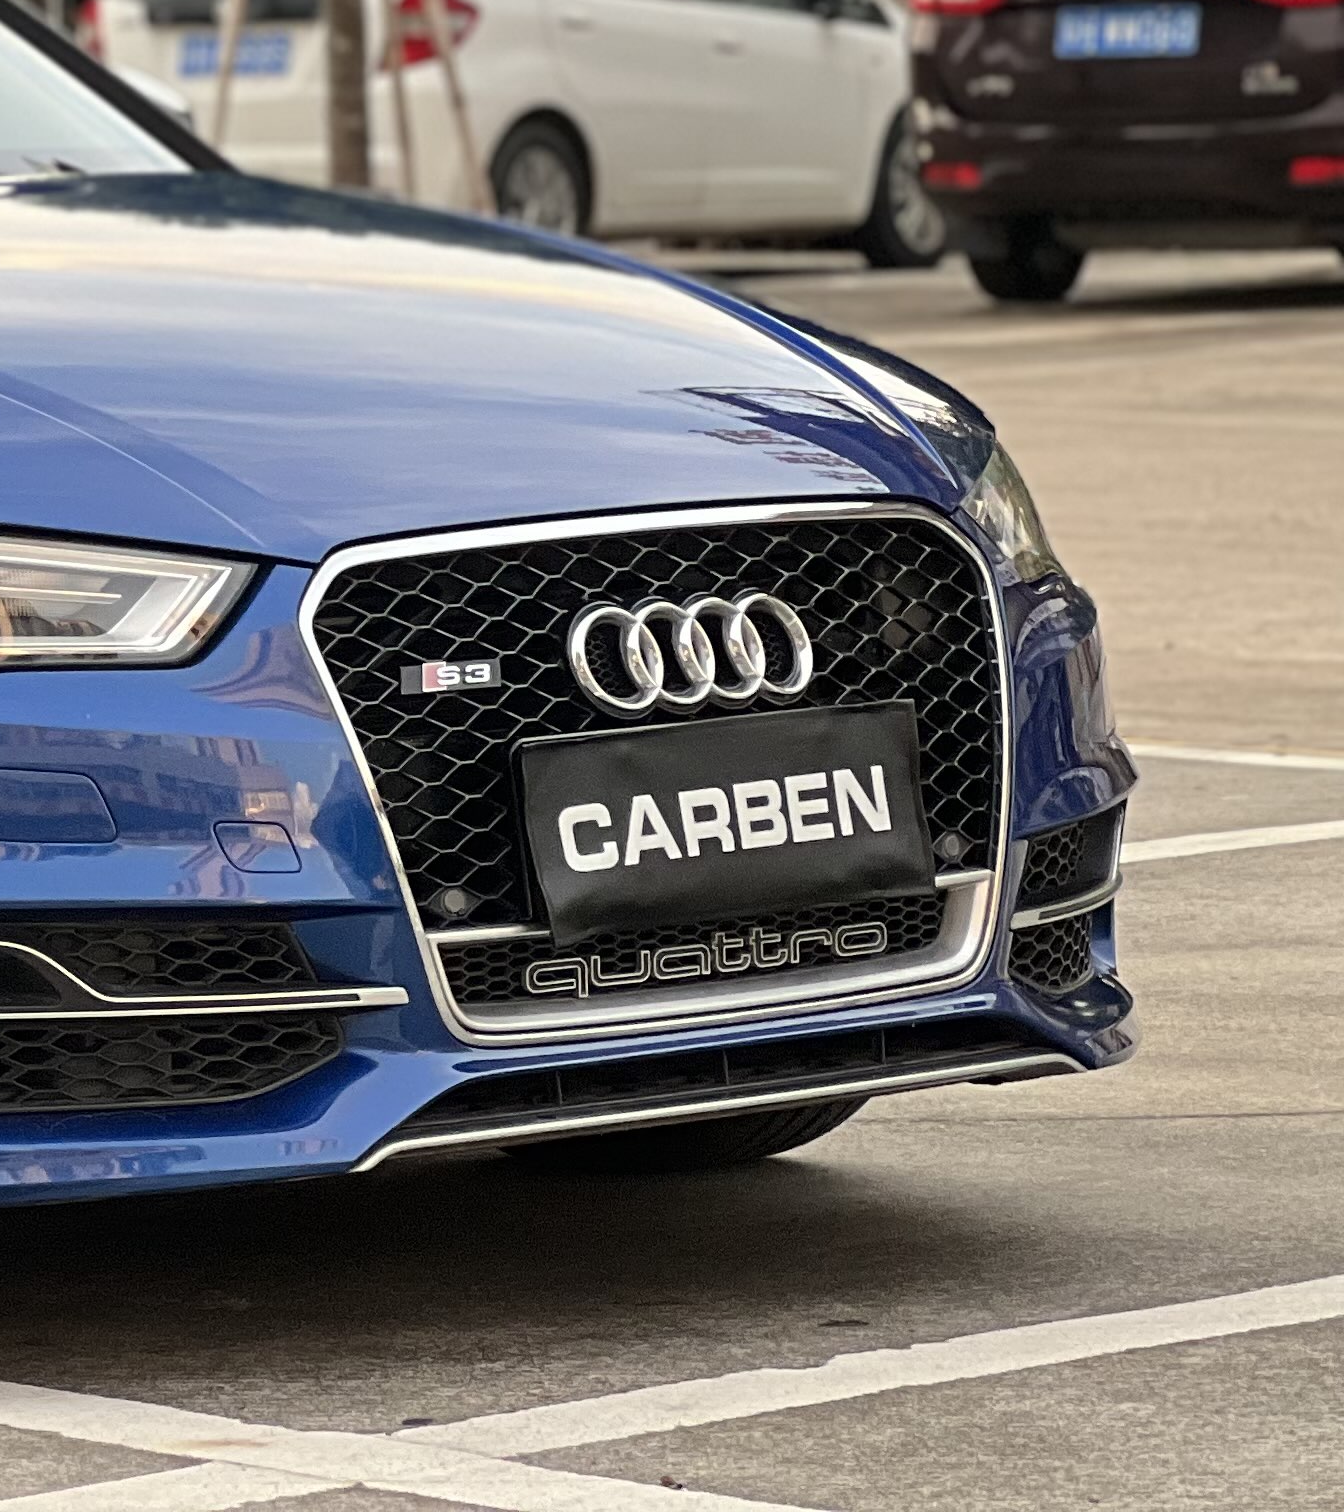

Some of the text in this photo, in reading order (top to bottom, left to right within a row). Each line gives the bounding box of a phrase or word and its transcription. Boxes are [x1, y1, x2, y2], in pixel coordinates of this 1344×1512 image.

[436, 663, 491, 686] S3
[558, 764, 892, 872] CARBEN
[526, 921, 888, 998] quattro
